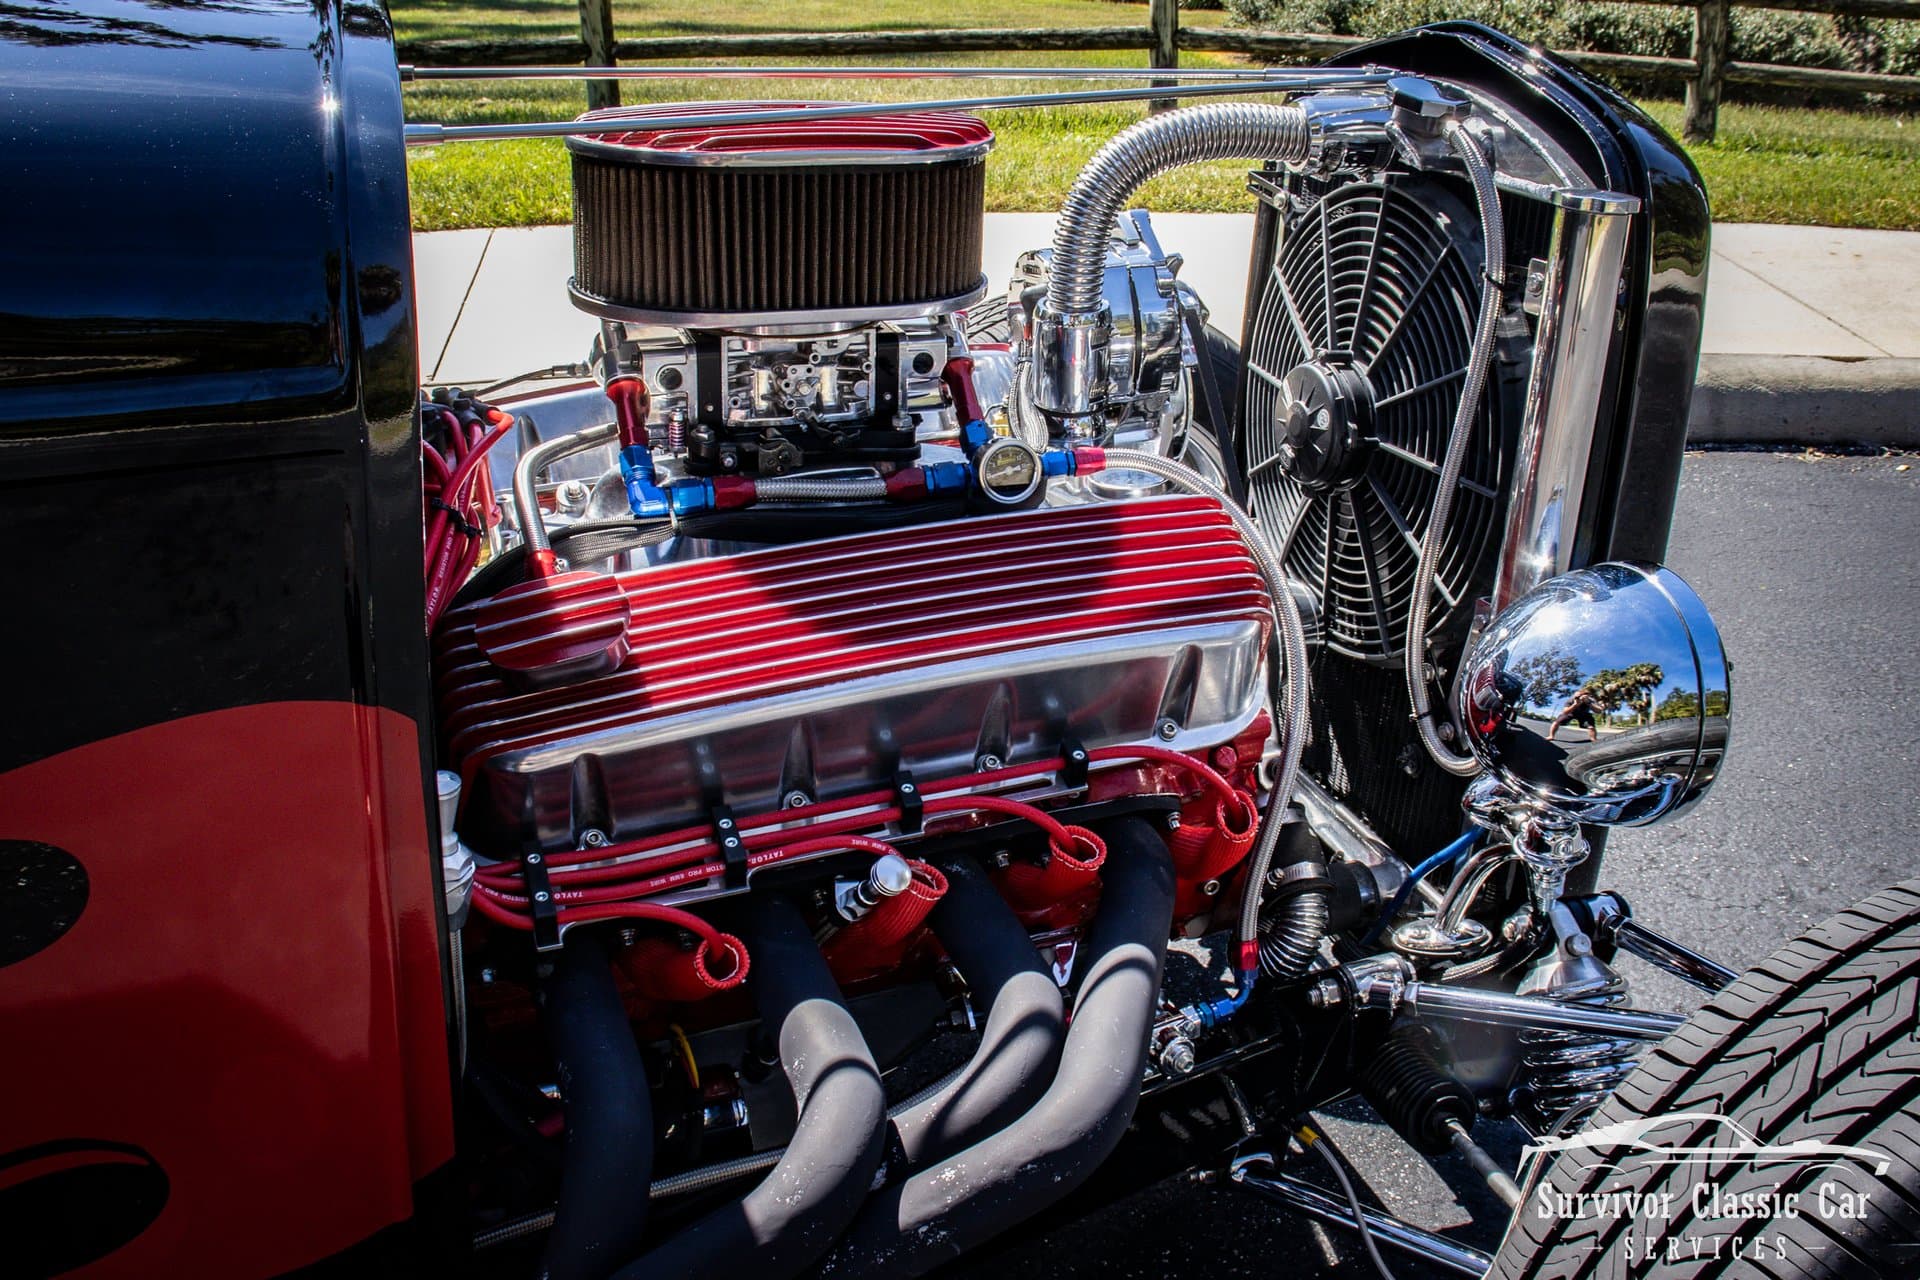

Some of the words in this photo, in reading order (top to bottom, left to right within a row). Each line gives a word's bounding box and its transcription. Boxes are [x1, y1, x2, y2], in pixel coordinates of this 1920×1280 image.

[687, 868, 703, 877] PRO
[649, 877, 666, 887] WIRE
[553, 890, 584, 900] TAYLO
